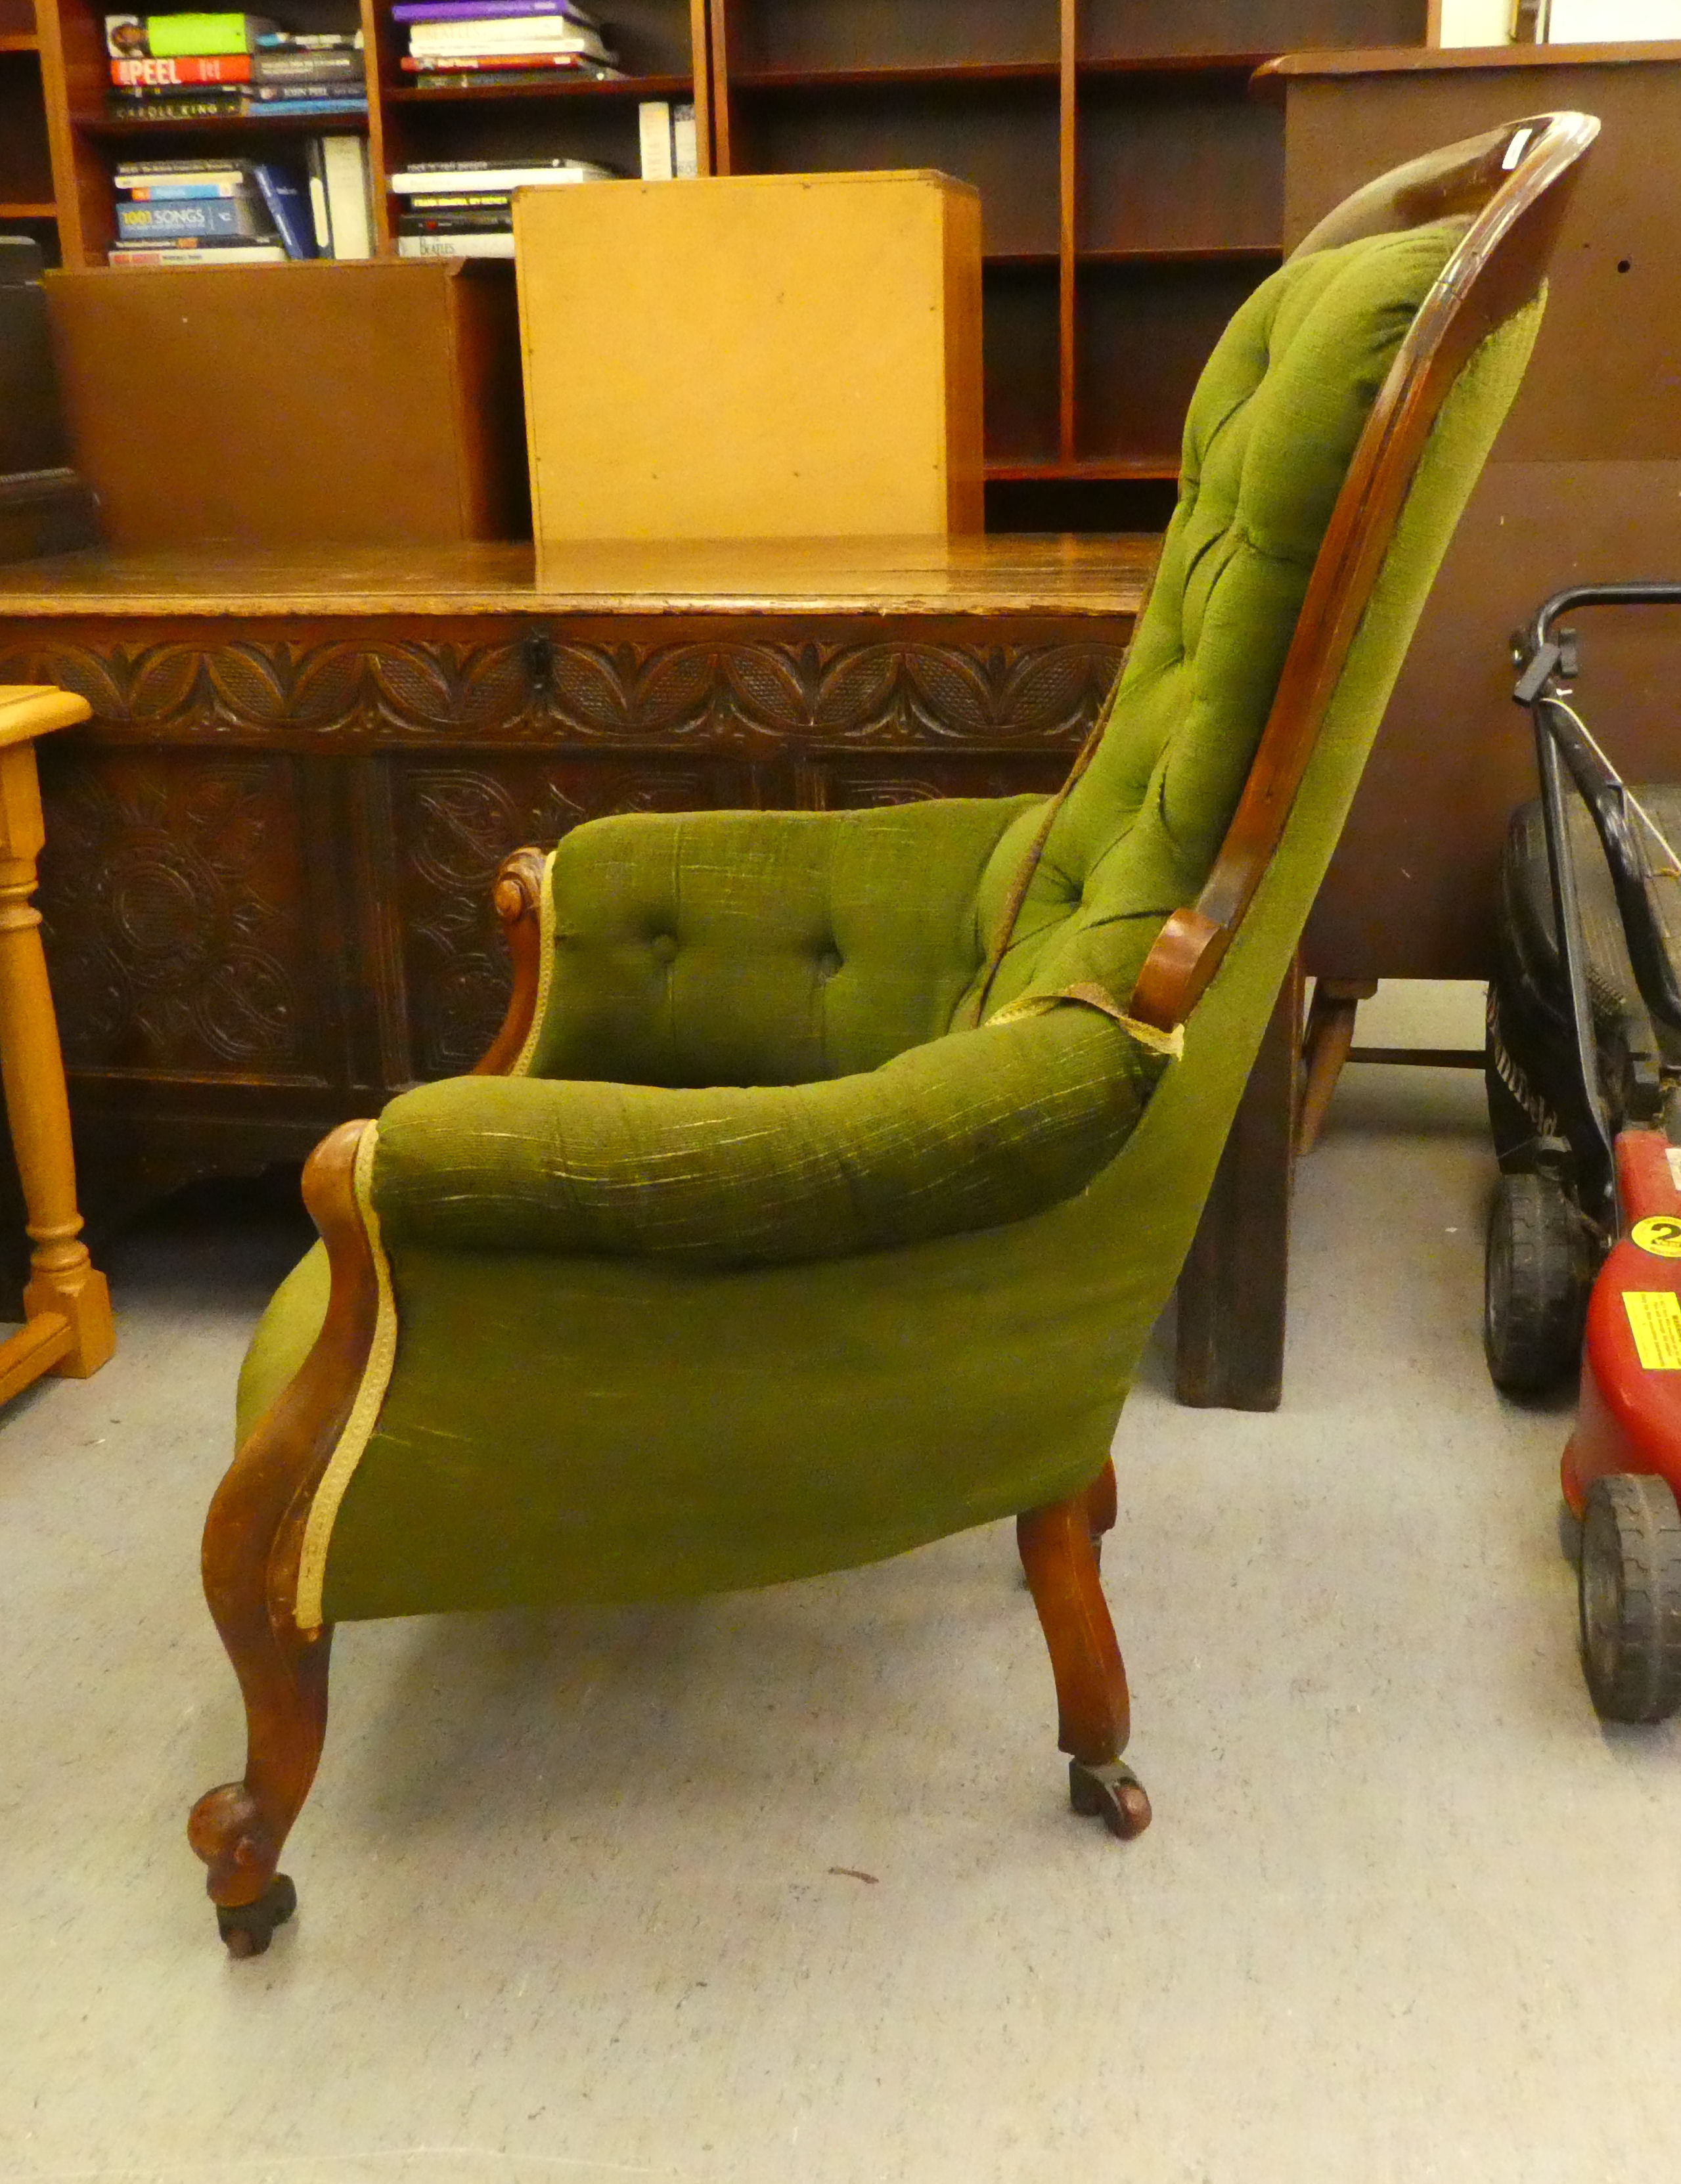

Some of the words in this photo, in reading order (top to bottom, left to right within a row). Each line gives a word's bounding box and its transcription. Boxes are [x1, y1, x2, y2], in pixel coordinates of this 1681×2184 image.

[129, 59, 183, 85] PEEL
[121, 210, 152, 226] 1001
[154, 208, 205, 225] SONGS
[1651, 1222, 1681, 1245] 2
